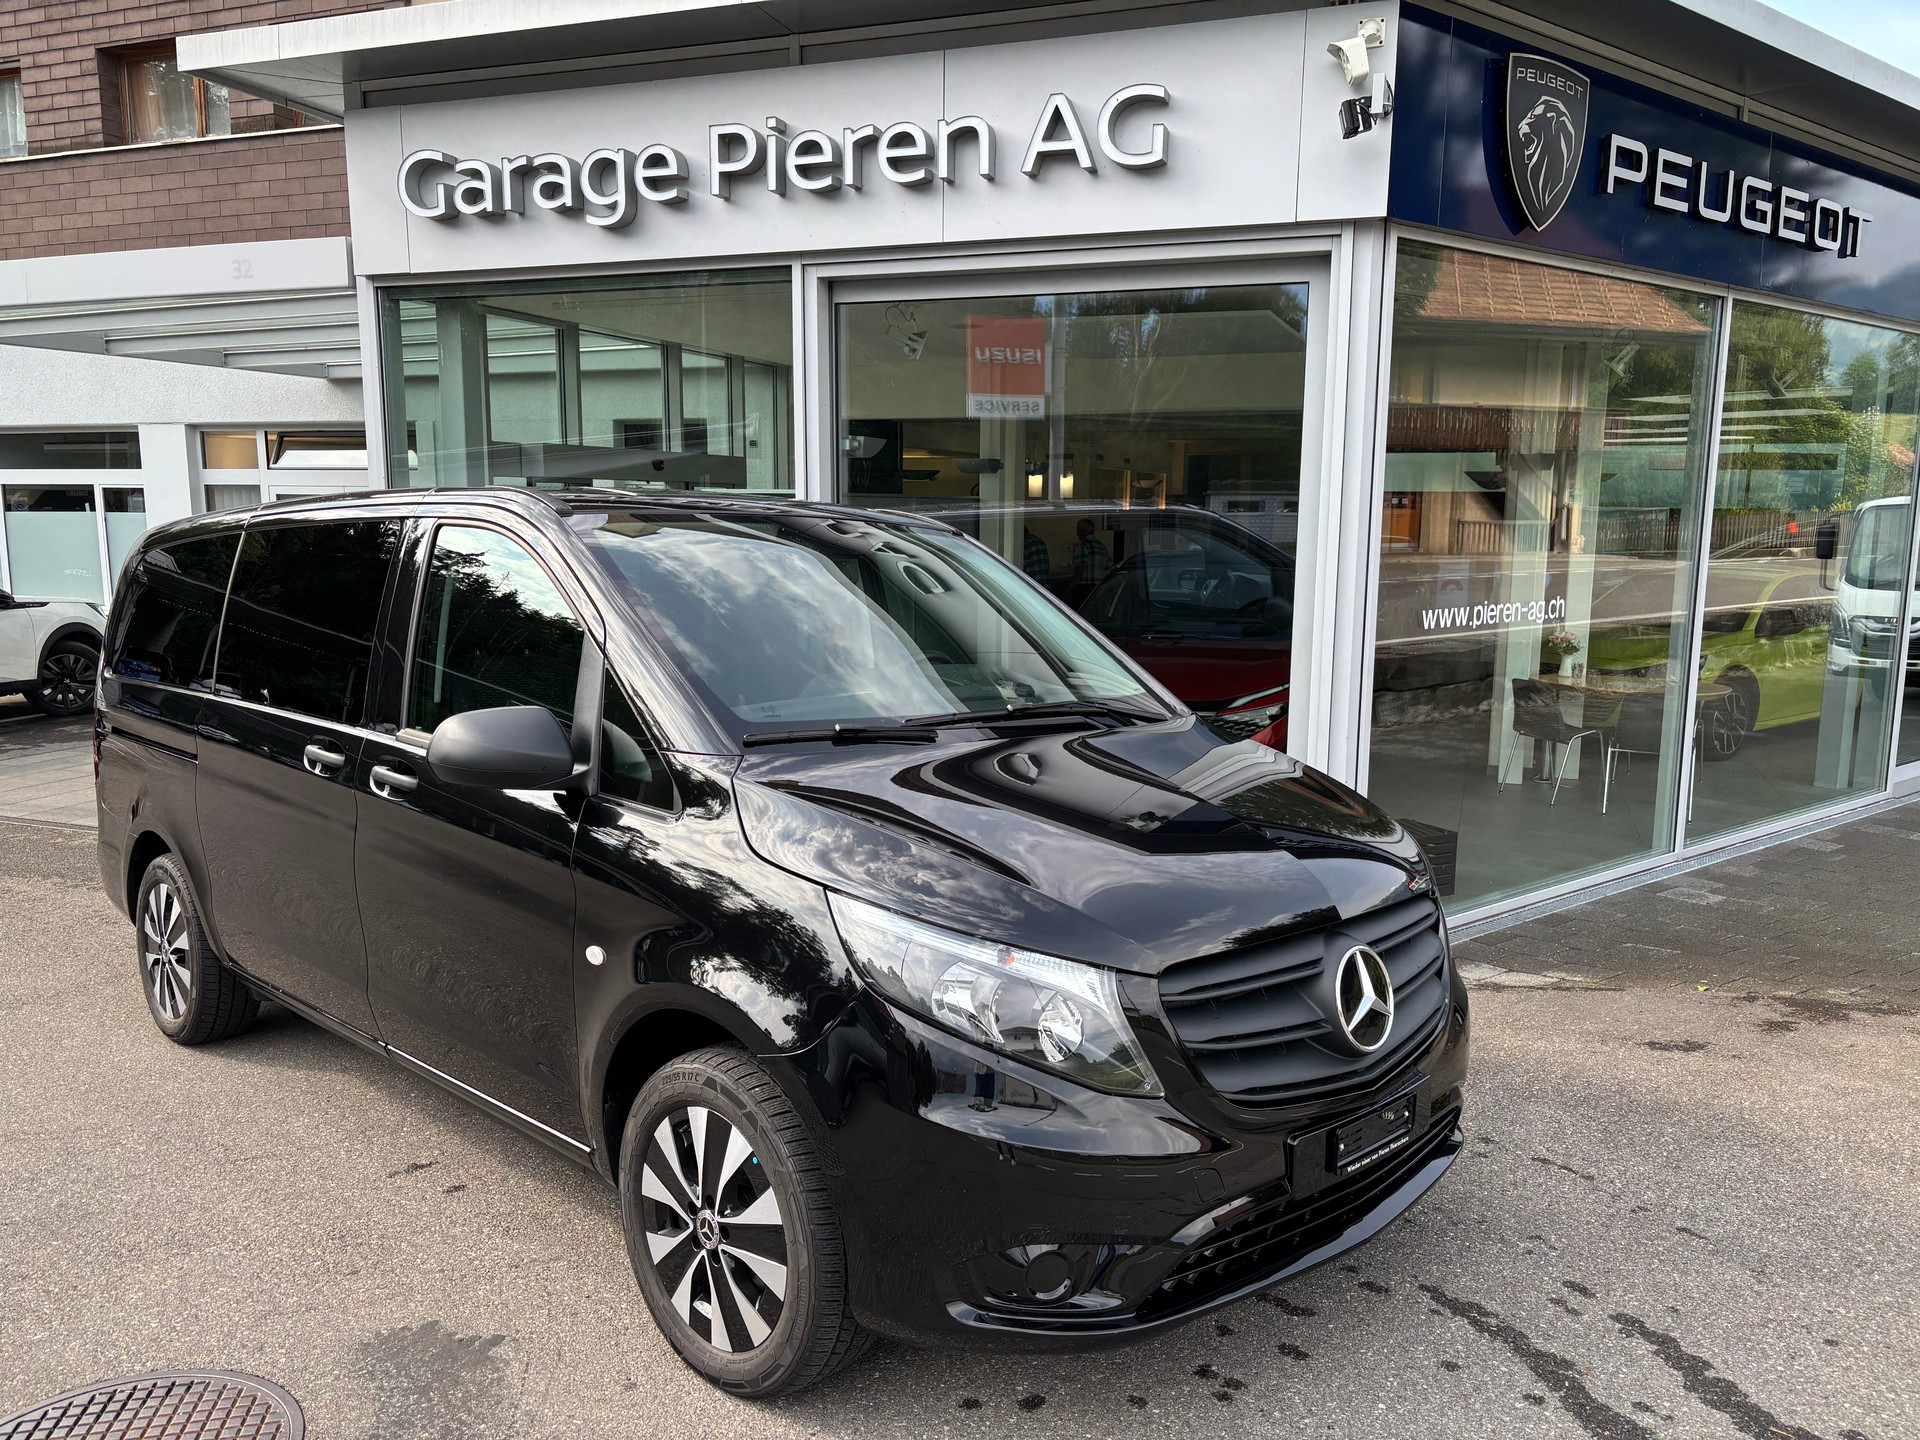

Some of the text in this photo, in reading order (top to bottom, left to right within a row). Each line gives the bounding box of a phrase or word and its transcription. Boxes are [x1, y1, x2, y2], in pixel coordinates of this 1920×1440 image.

[1516, 67, 1584, 99] PEUGEOT
[397, 83, 1170, 228] Garage Pieren AG
[1607, 133, 1874, 258] PEUGEOT
[231, 259, 254, 280] 32
[1422, 595, 1565, 630] www.pieren-ag.ch
